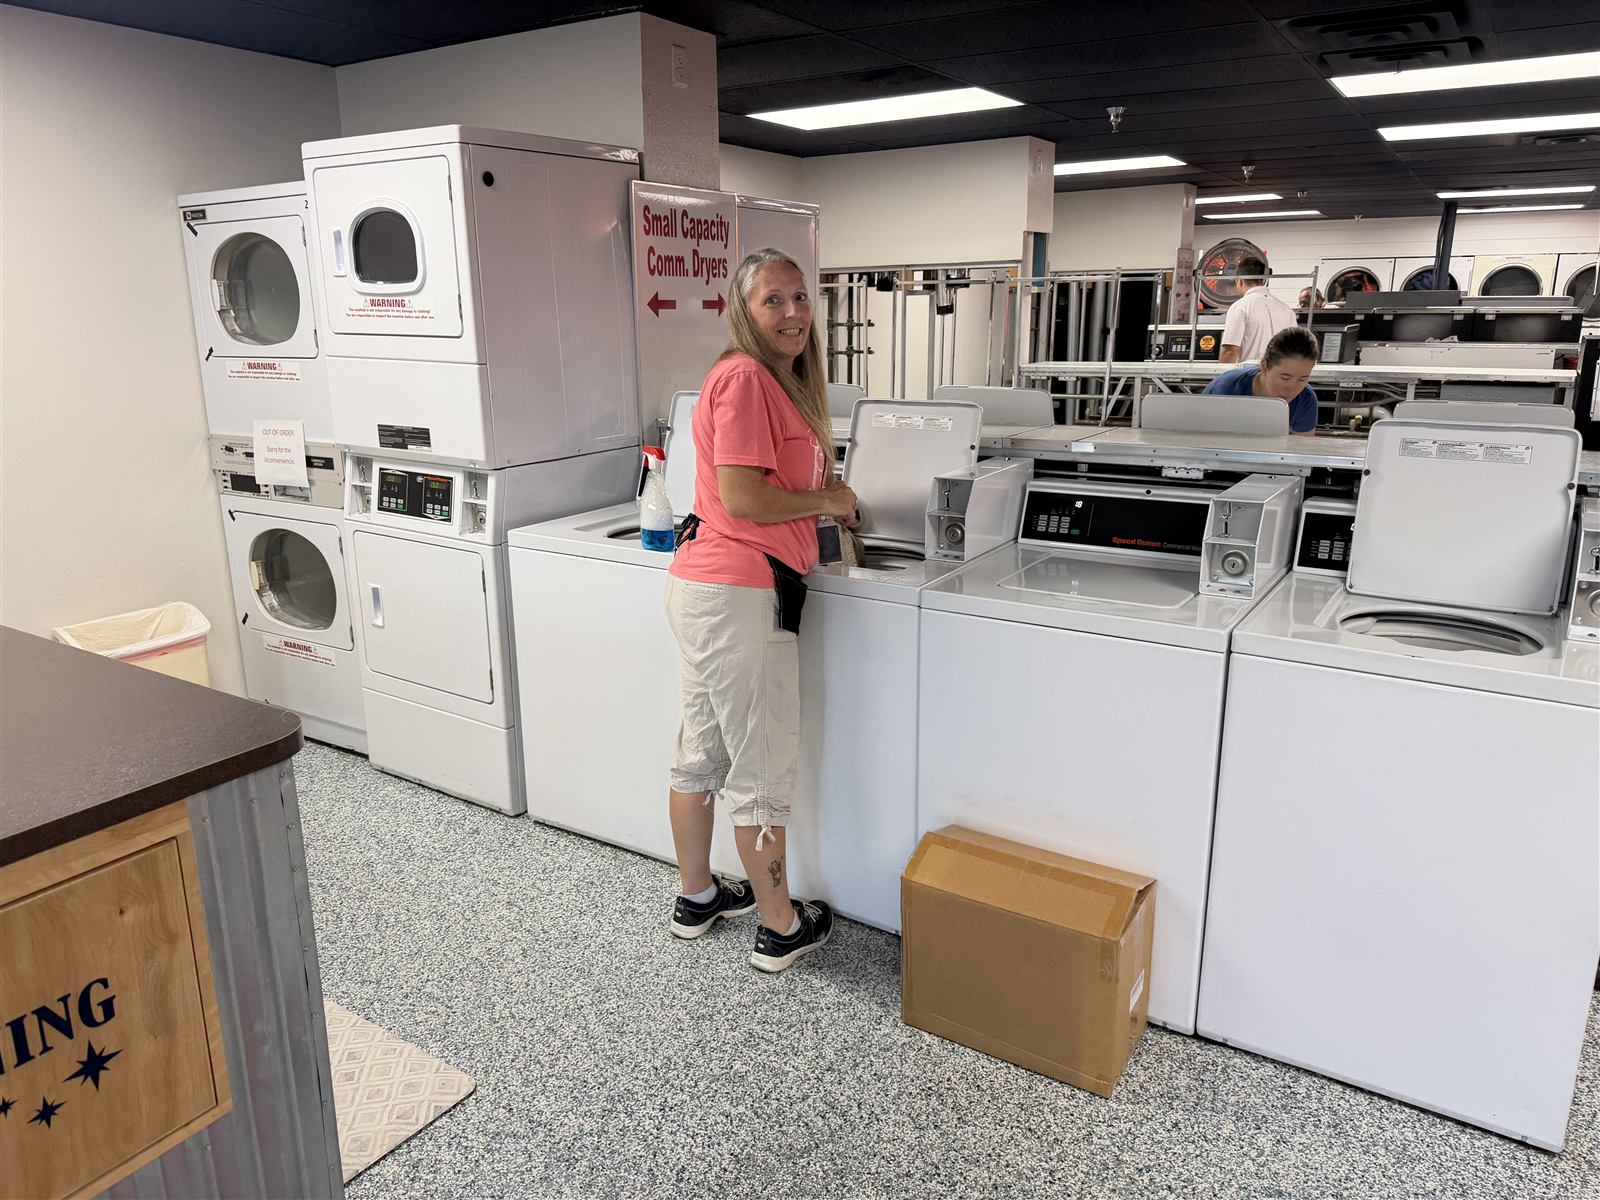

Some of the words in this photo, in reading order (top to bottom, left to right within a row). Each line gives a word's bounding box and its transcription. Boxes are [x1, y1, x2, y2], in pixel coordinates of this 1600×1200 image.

[642, 204, 677, 238] Small
[681, 208, 730, 250] Capacity
[647, 245, 689, 277] Comm.
[692, 248, 728, 286] Dryers
[369, 298, 406, 308] WARNING
[246, 361, 277, 371] WARNING
[262, 428, 271, 436] OUT
[279, 429, 295, 437] ORDER
[1112, 536, 1136, 545] Speed
[1137, 539, 1161, 548] Queen
[283, 640, 313, 653] WARNING
